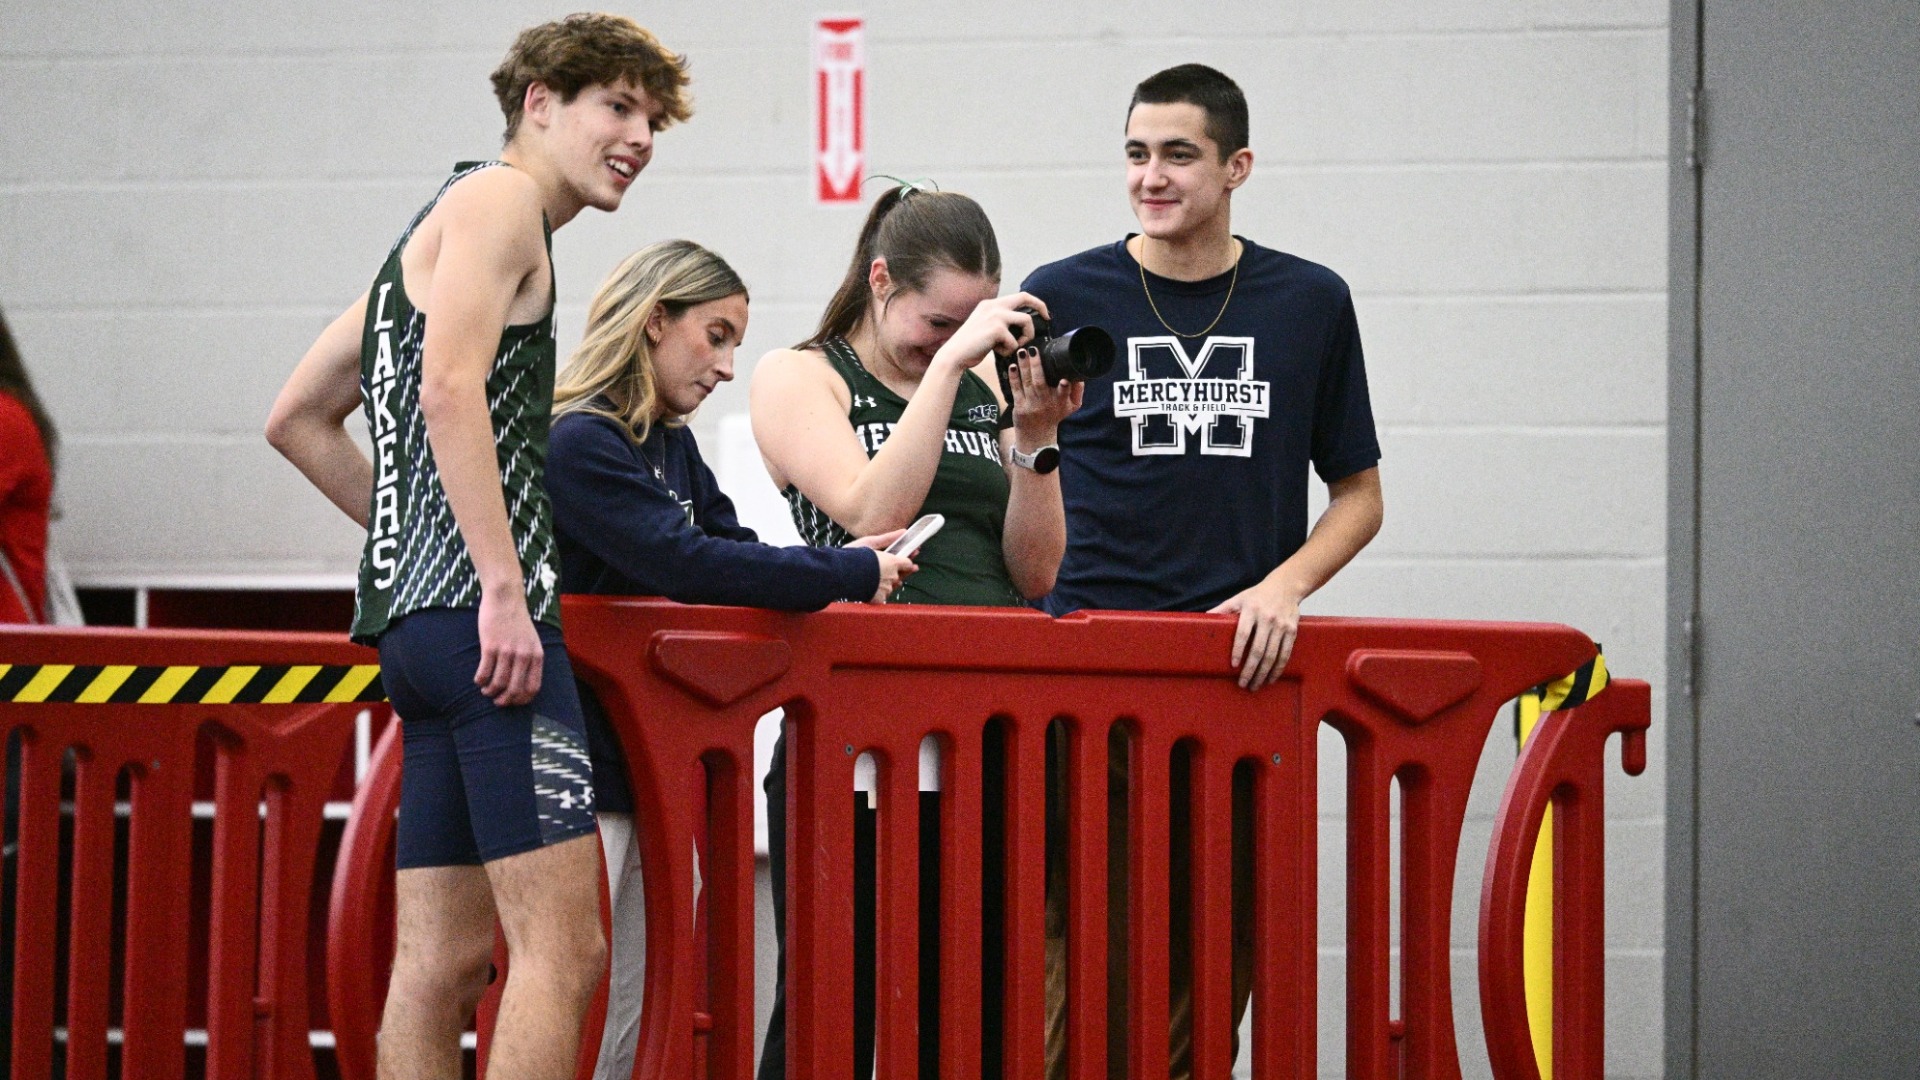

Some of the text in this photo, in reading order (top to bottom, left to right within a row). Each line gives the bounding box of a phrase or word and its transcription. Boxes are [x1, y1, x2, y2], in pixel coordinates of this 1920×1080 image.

[1118, 382, 1266, 404] MERCYHURST
[1161, 403, 1226, 412] TRACK & FIELD
[371, 281, 399, 591] LAKERS
